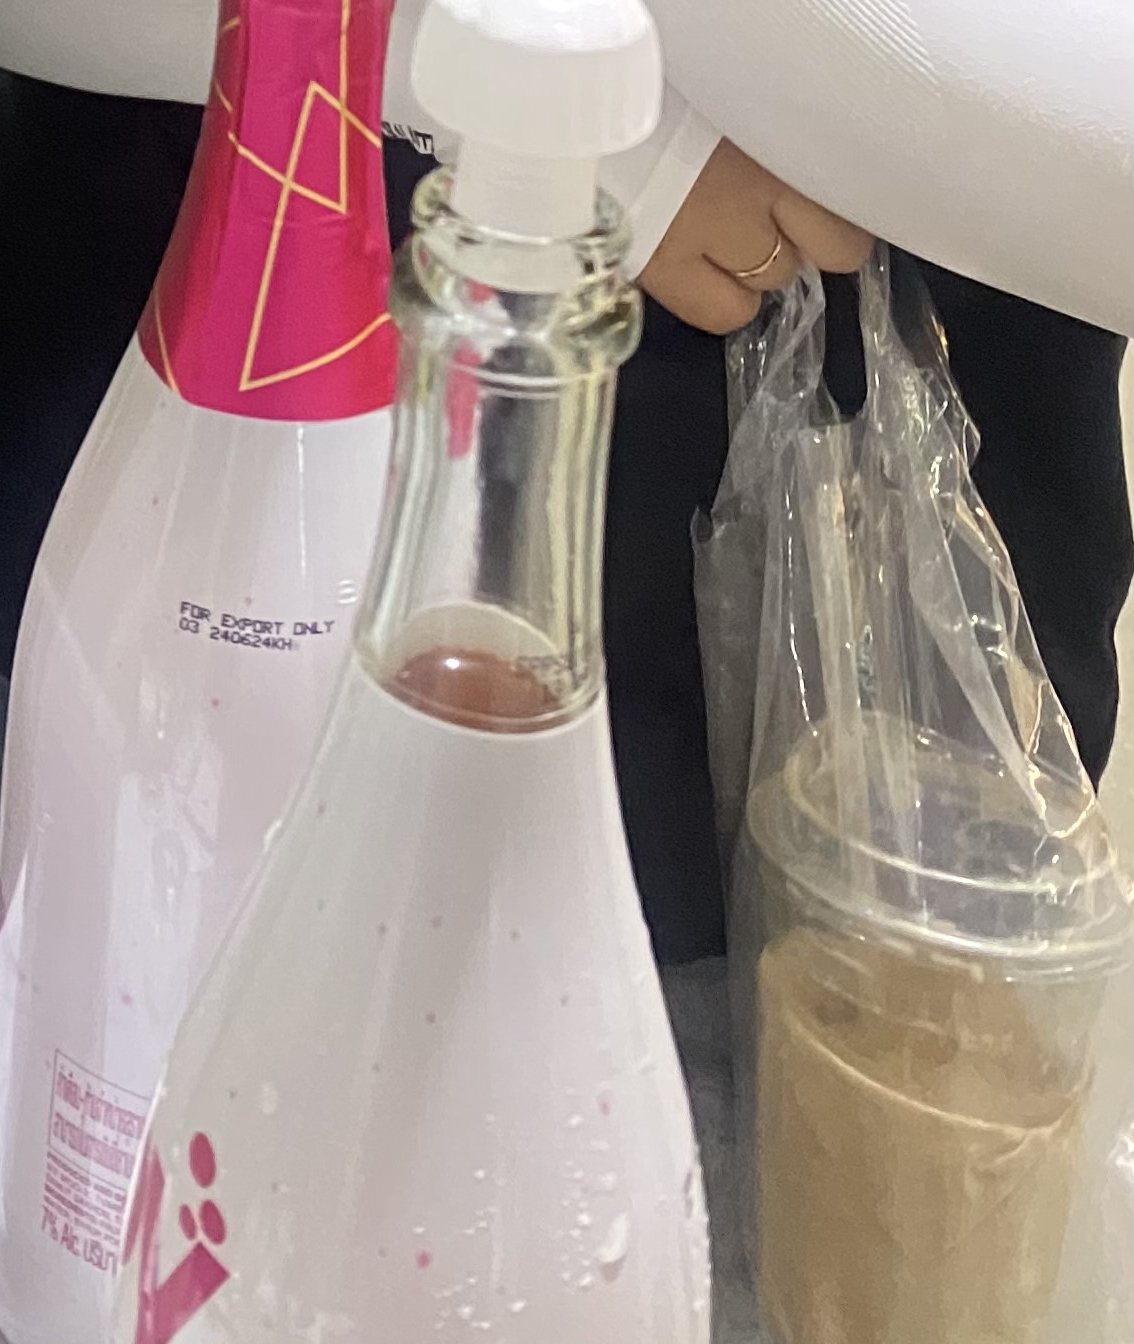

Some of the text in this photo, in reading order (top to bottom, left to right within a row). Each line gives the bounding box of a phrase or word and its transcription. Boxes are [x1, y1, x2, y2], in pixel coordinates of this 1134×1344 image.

[178, 616, 200, 634] 03
[179, 601, 335, 636] FOR EXPORT ONLY
